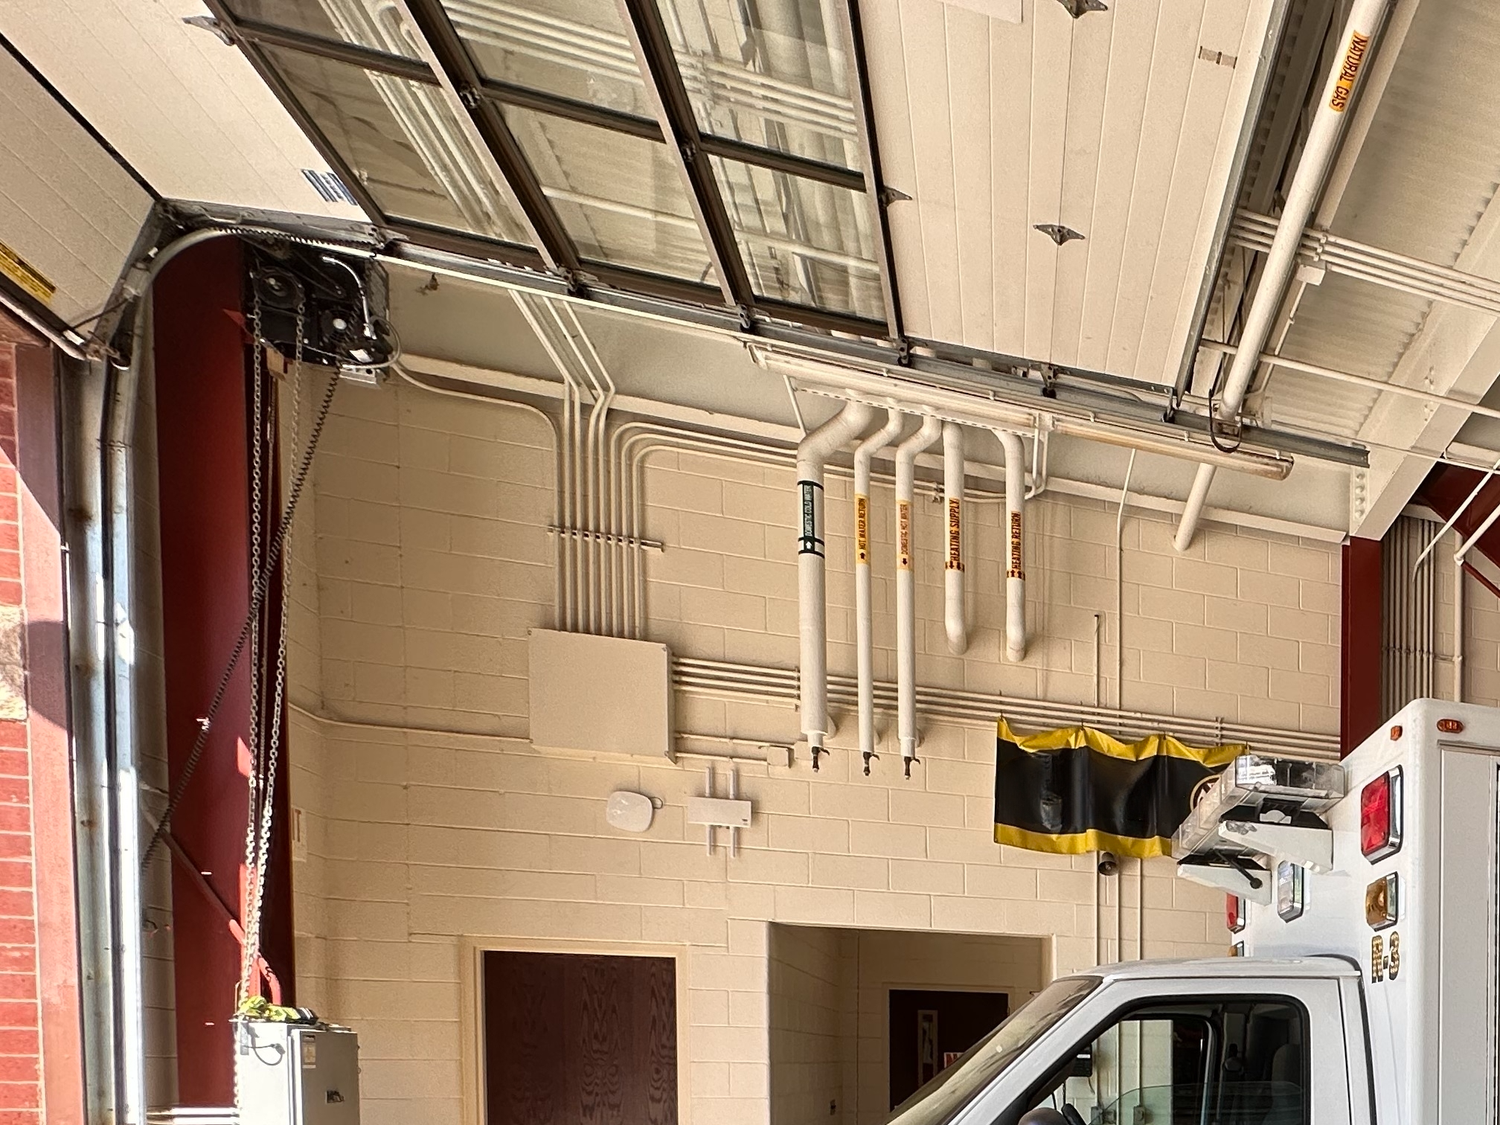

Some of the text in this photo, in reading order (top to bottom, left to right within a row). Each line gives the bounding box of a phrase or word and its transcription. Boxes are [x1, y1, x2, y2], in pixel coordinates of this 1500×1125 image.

[1331, 34, 1368, 108] NATURAL GAS
[803, 484, 813, 537] DOMESTIC COLD WATER
[900, 503, 908, 519] WATER
[949, 498, 960, 528] SUPPLY
[858, 519, 866, 538] WATER
[900, 520, 908, 530] HOT
[1010, 512, 1021, 540] RETURN
[858, 539, 866, 550] HOT
